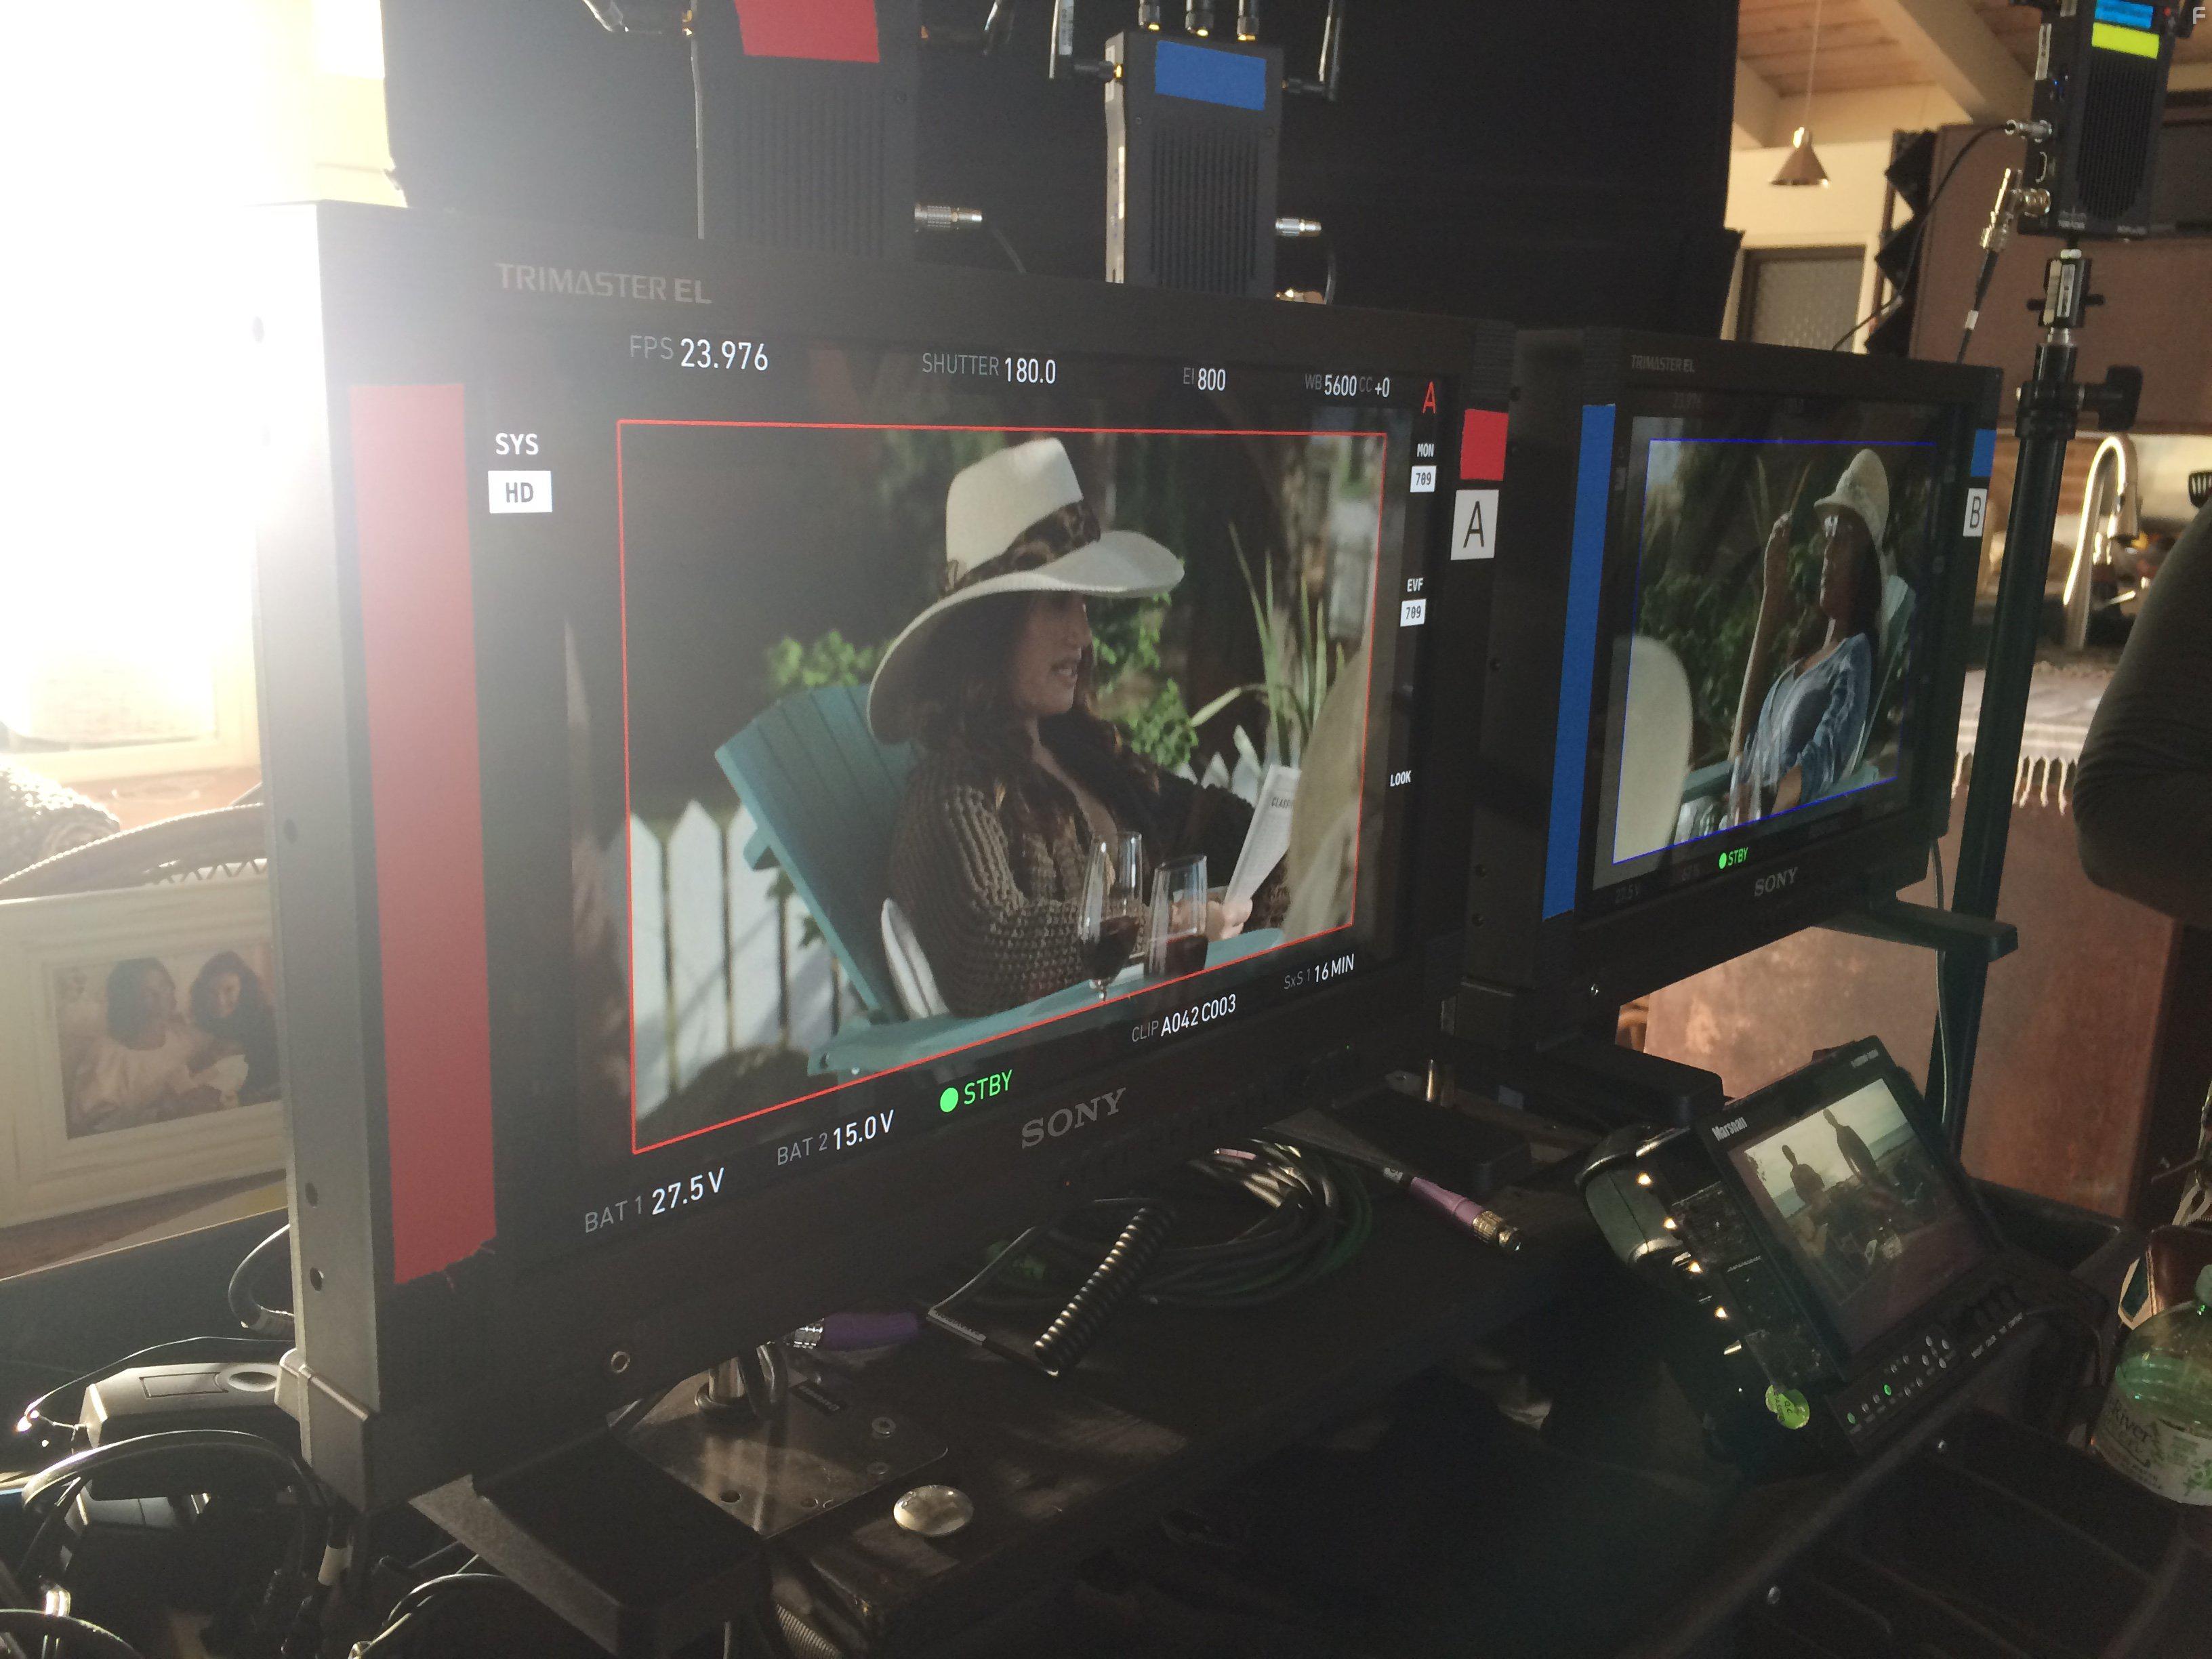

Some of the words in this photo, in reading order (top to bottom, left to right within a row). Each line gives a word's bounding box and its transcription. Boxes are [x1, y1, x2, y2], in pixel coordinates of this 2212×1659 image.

[496, 263, 666, 302] TRIMASTER
[674, 276, 712, 304] EL
[630, 335, 674, 360] FPS
[680, 338, 769, 371] 23.976
[1631, 354, 1682, 371] TRIMASTER
[922, 352, 1000, 377] SHUTTER
[1005, 357, 1057, 384] 180.0
[1197, 367, 1227, 391] 800
[1305, 373, 1322, 391] WB
[1324, 374, 1357, 397] 5600
[1374, 376, 1390, 398] +0
[1422, 381, 1436, 414] A
[495, 433, 539, 455] SYS
[1416, 443, 1435, 457] MON
[505, 481, 534, 503] HD
[1462, 500, 1485, 548] A
[1969, 496, 1982, 530] B
[1406, 577, 1424, 592] EVF
[1390, 770, 1412, 787] LOOK
[1727, 846, 1749, 867] STBY
[1753, 866, 1799, 897] SONY
[1284, 970, 1304, 989] SxS
[1132, 1020, 1160, 1042] CLIP
[964, 1069, 1014, 1105] STBY
[1021, 1088, 1126, 1149] SONY
[777, 1137, 813, 1166] BAT
[818, 1132, 828, 1151] 2
[585, 1199, 629, 1233] BAT
[634, 1195, 642, 1214] 1
